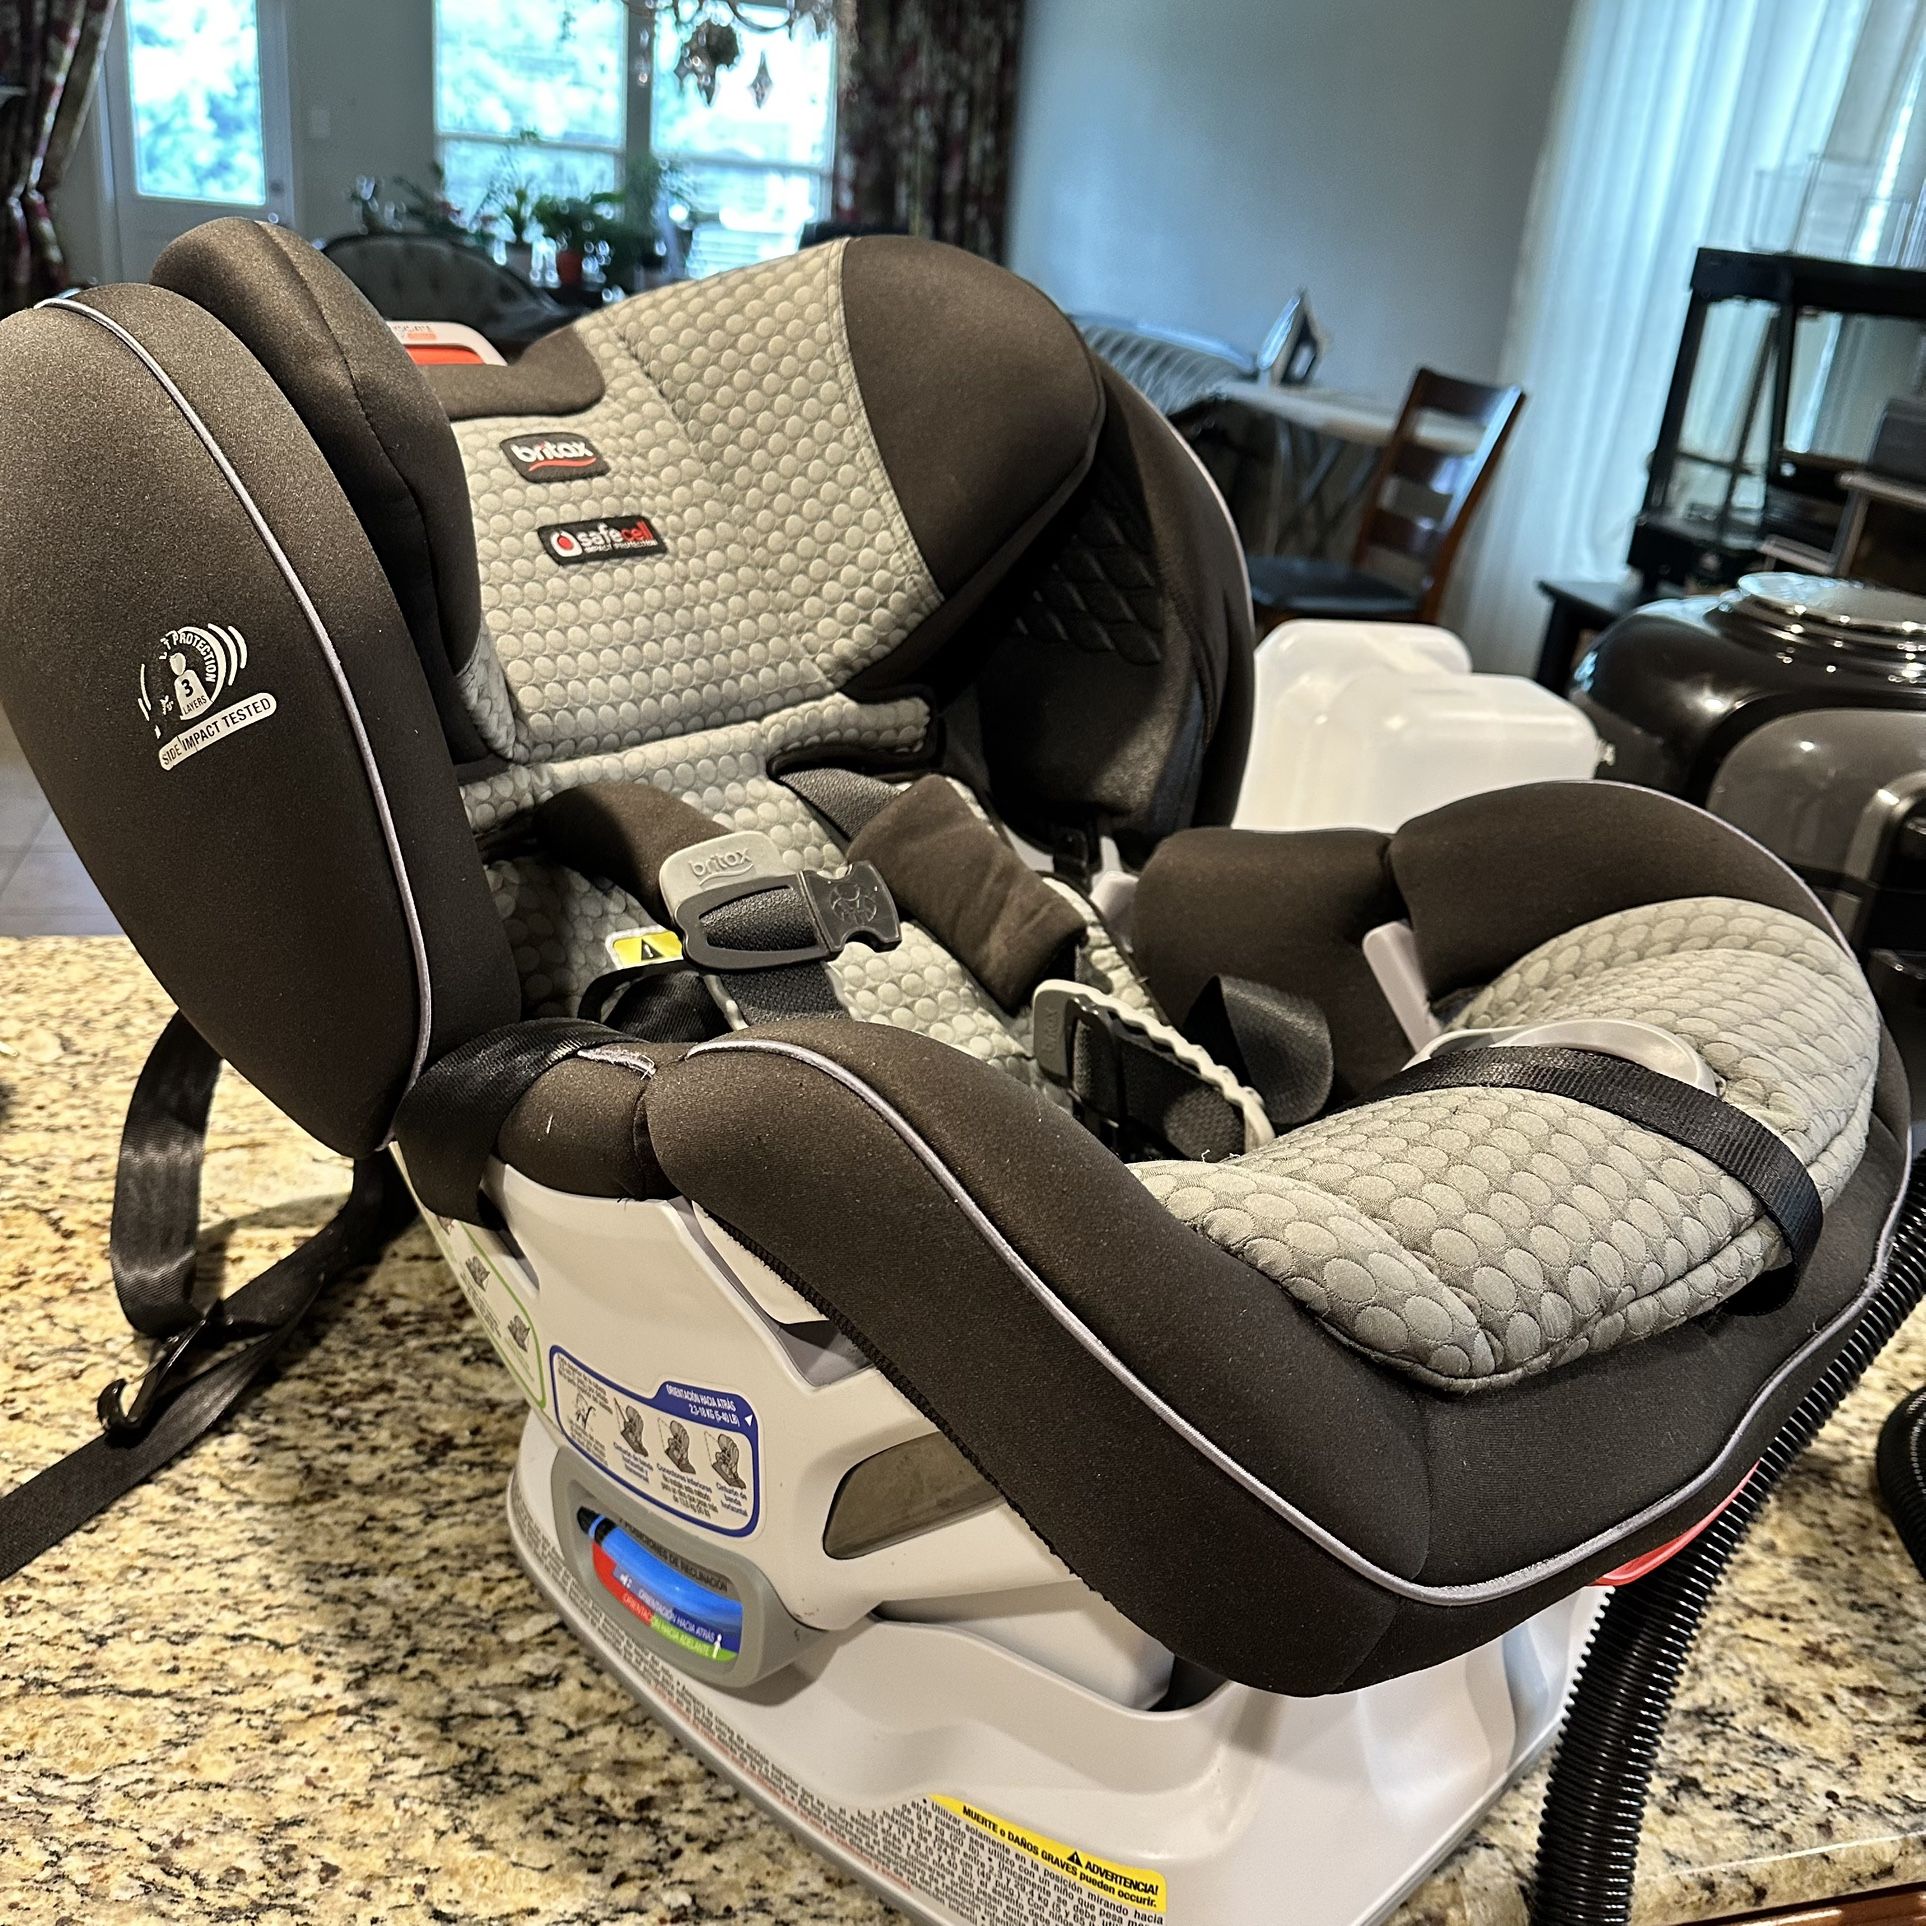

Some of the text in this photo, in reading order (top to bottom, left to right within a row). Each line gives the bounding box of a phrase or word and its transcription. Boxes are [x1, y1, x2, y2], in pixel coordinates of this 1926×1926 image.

[511, 441, 594, 463] britax
[576, 521, 654, 547] safecell
[172, 633, 217, 683] PROTECTION
[181, 678, 194, 697] 3
[182, 695, 208, 715] LAYERS
[162, 697, 271, 766] SIDE IMPACT TESTED
[688, 848, 752, 878] britax
[931, 1801, 1163, 1926] Utilizar solamente en la posición mirando hacia
[934, 1815, 966, 1839] cuando
[988, 1846, 1015, 1868] utilizo
[1018, 1863, 1035, 1879] con
[1038, 1875, 1050, 1888] un
[1053, 1881, 1074, 1901] niño
[1077, 1896, 1096, 1913] que
[1099, 1907, 1124, 1926] pesa
[962, 1804, 1157, 1908] MUERTE o DAÑOS GRAVES pueden occurir.
[1085, 1861, 1160, 1896] ADVERTENCIA!
[1038, 1892, 1049, 1908] kg
[1056, 1895, 1068, 1907] se
[1072, 1903, 1097, 1922] debe
